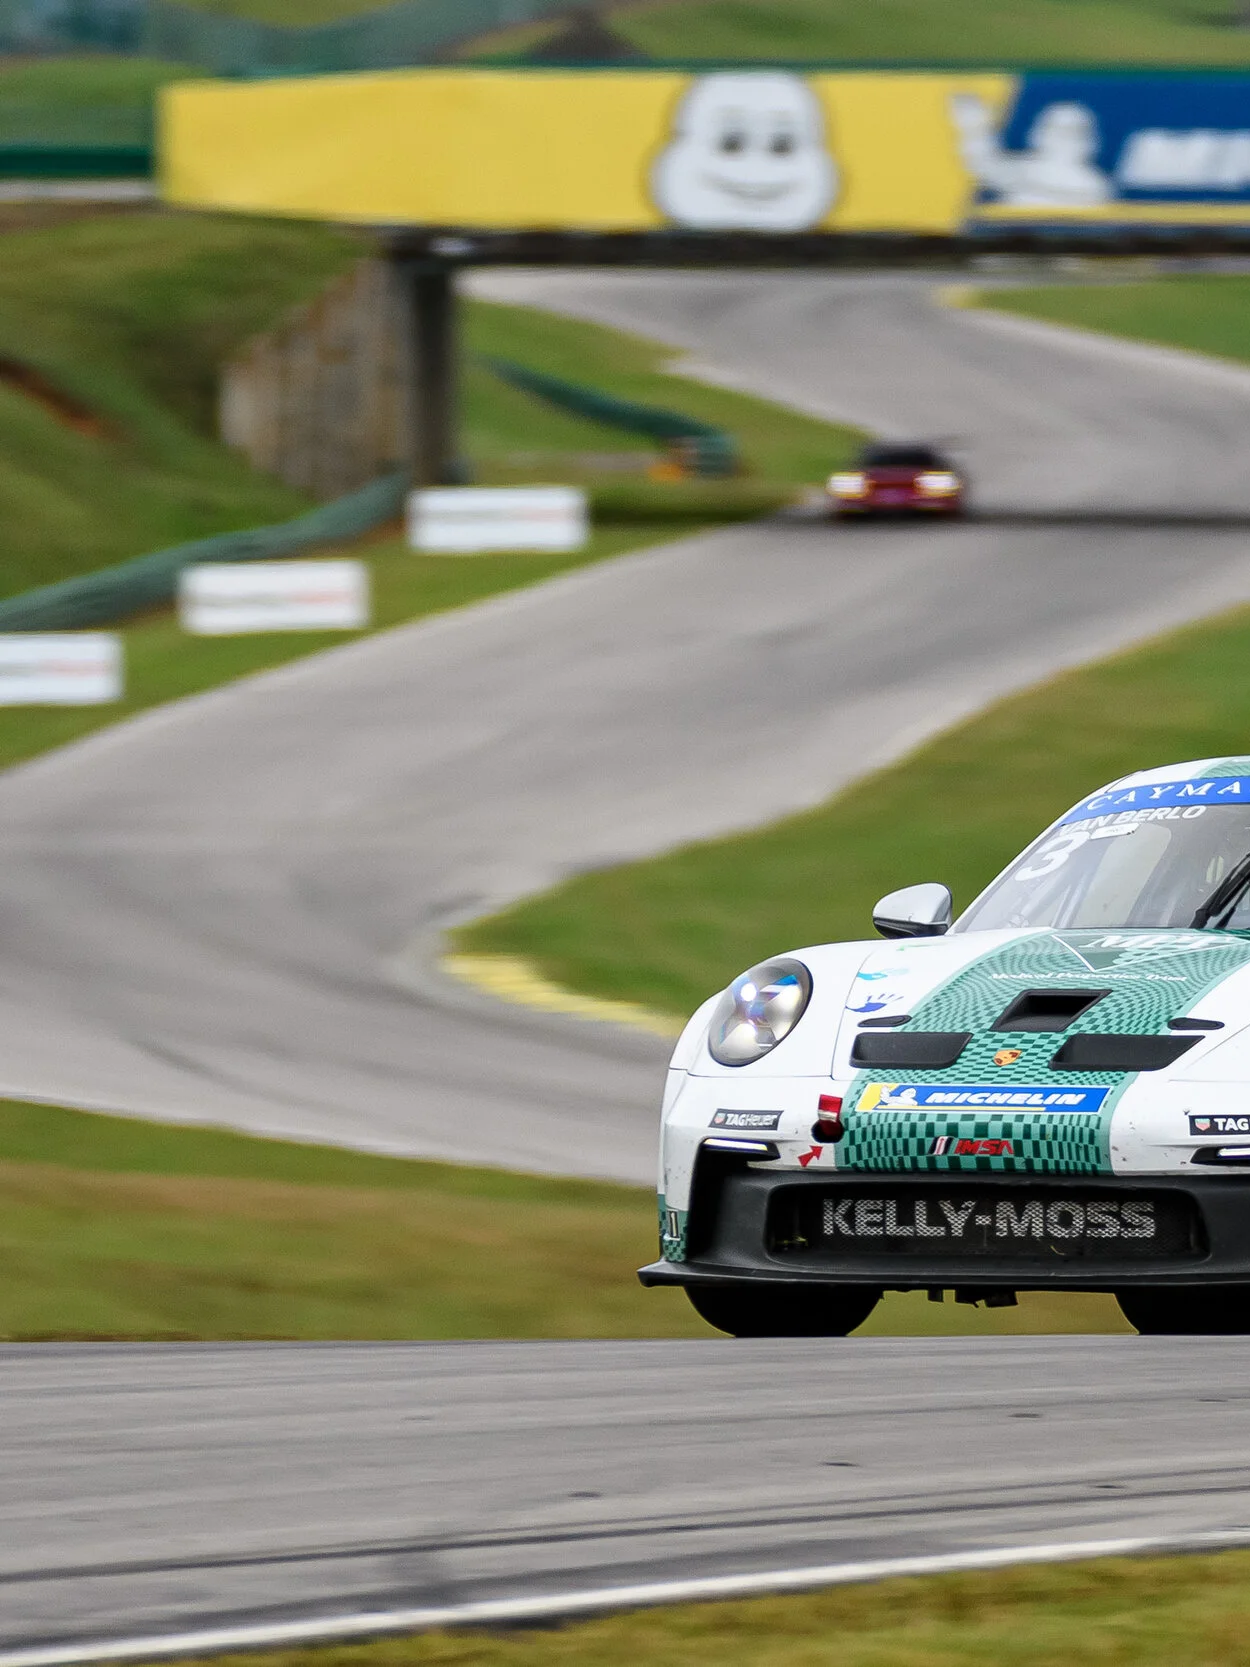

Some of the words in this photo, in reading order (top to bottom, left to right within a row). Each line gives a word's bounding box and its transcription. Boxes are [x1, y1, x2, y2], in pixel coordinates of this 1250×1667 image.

[1058, 814, 1115, 837] VAN
[1114, 805, 1207, 825] BERLO
[1014, 831, 1092, 881] 3
[924, 1092, 1087, 1105] MICHELIN
[822, 1199, 1156, 1238] KELLY-MOSS
